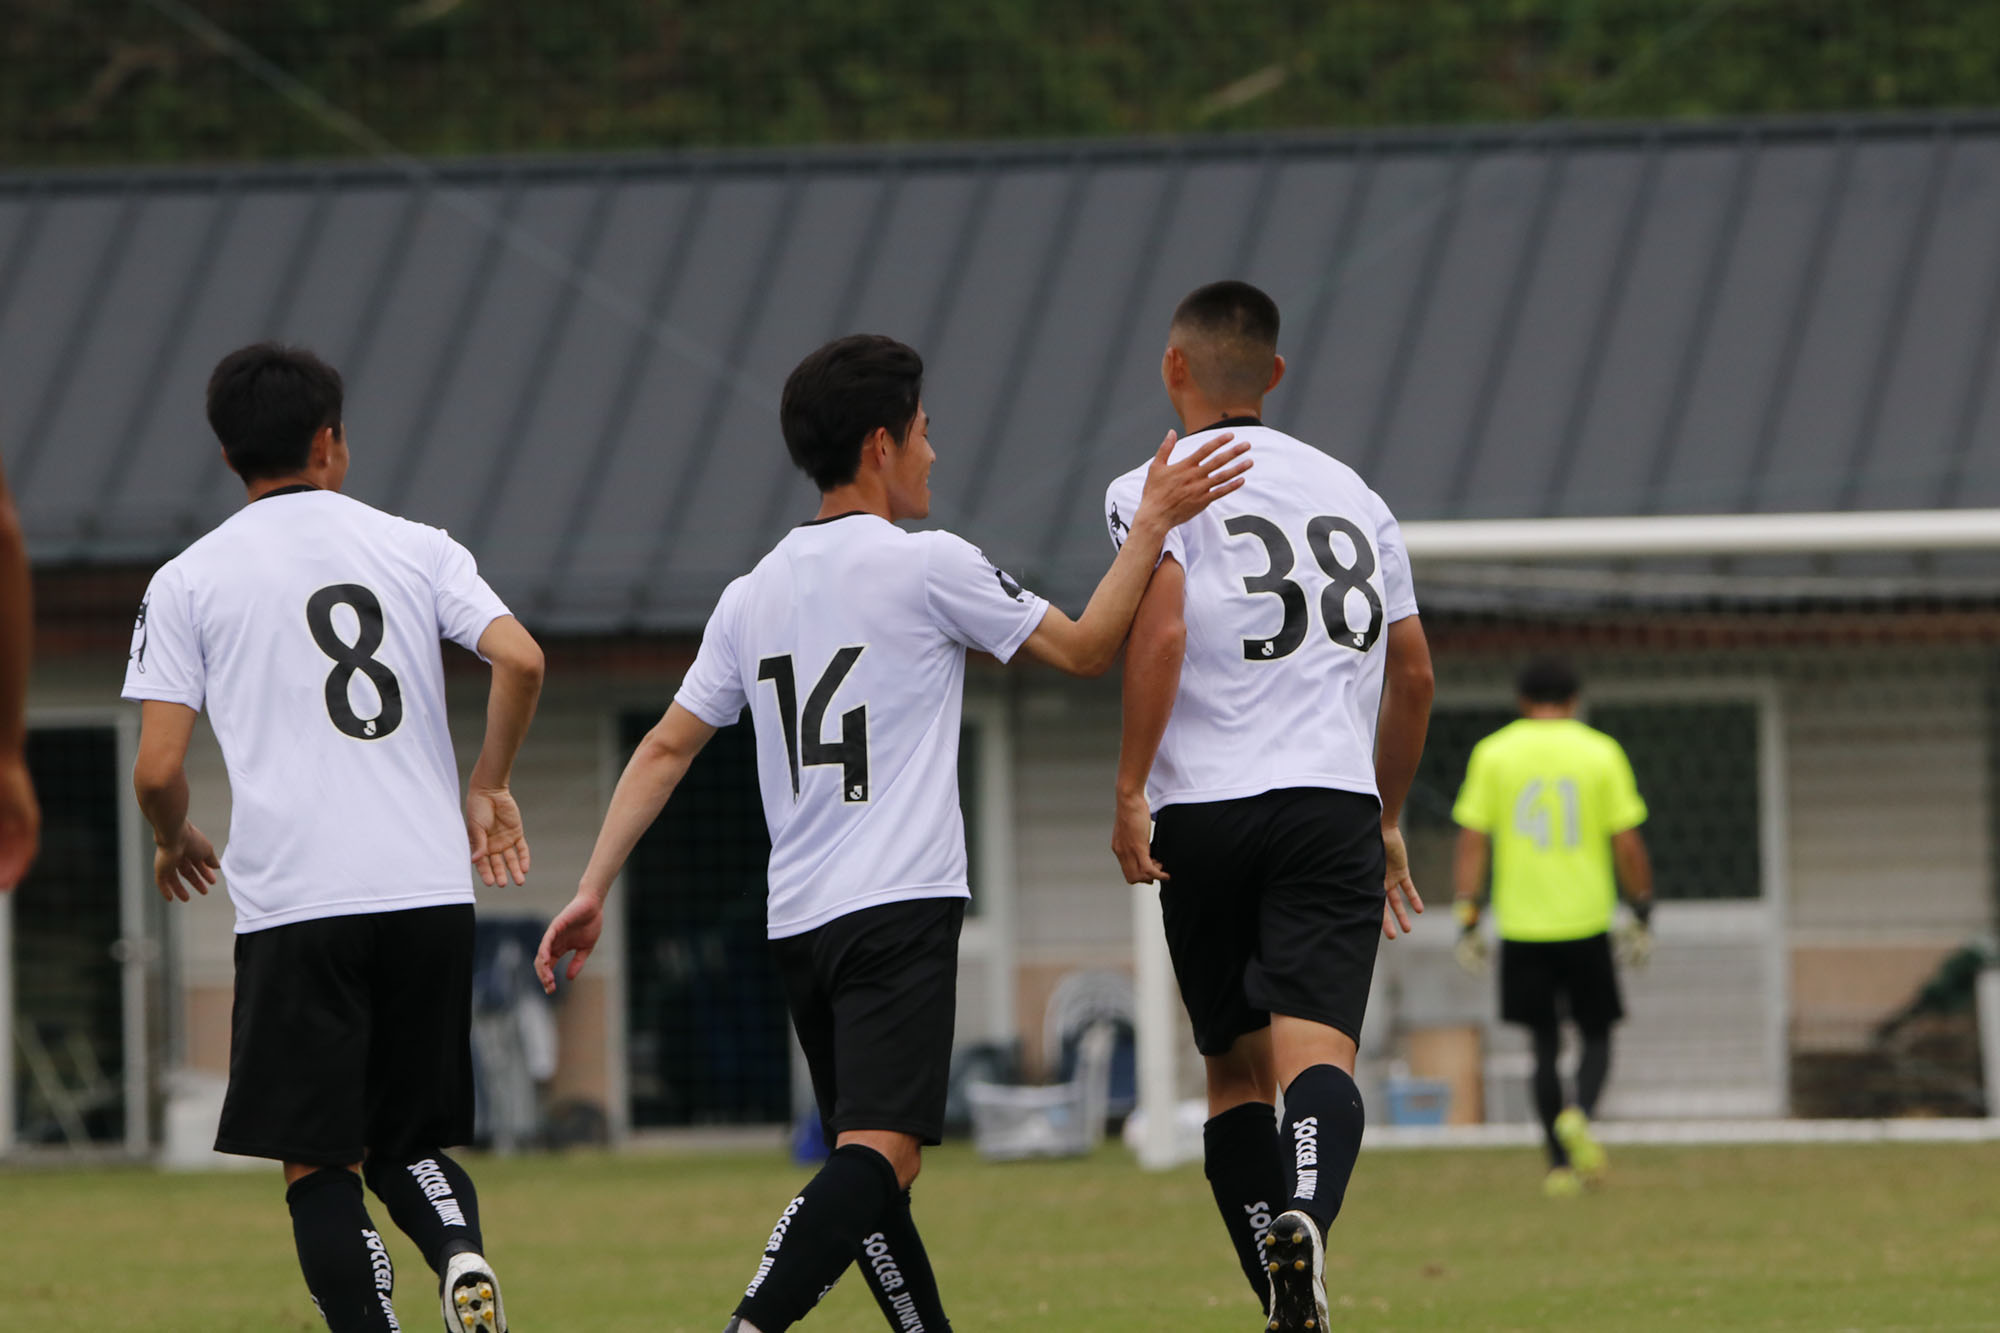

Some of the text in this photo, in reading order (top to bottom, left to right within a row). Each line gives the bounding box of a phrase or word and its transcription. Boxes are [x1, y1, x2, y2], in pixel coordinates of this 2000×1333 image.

[1224, 515, 1383, 660] 38
[306, 583, 403, 740] 8
[757, 646, 869, 805] 14
[1512, 777, 1583, 850] 41
[1292, 1116, 1318, 1169] SOCCER
[406, 1158, 453, 1201] SOCCER
[765, 1196, 805, 1252] SOCCER
[360, 1229, 392, 1291] SOCCER
[862, 1232, 904, 1292] SOCCER
